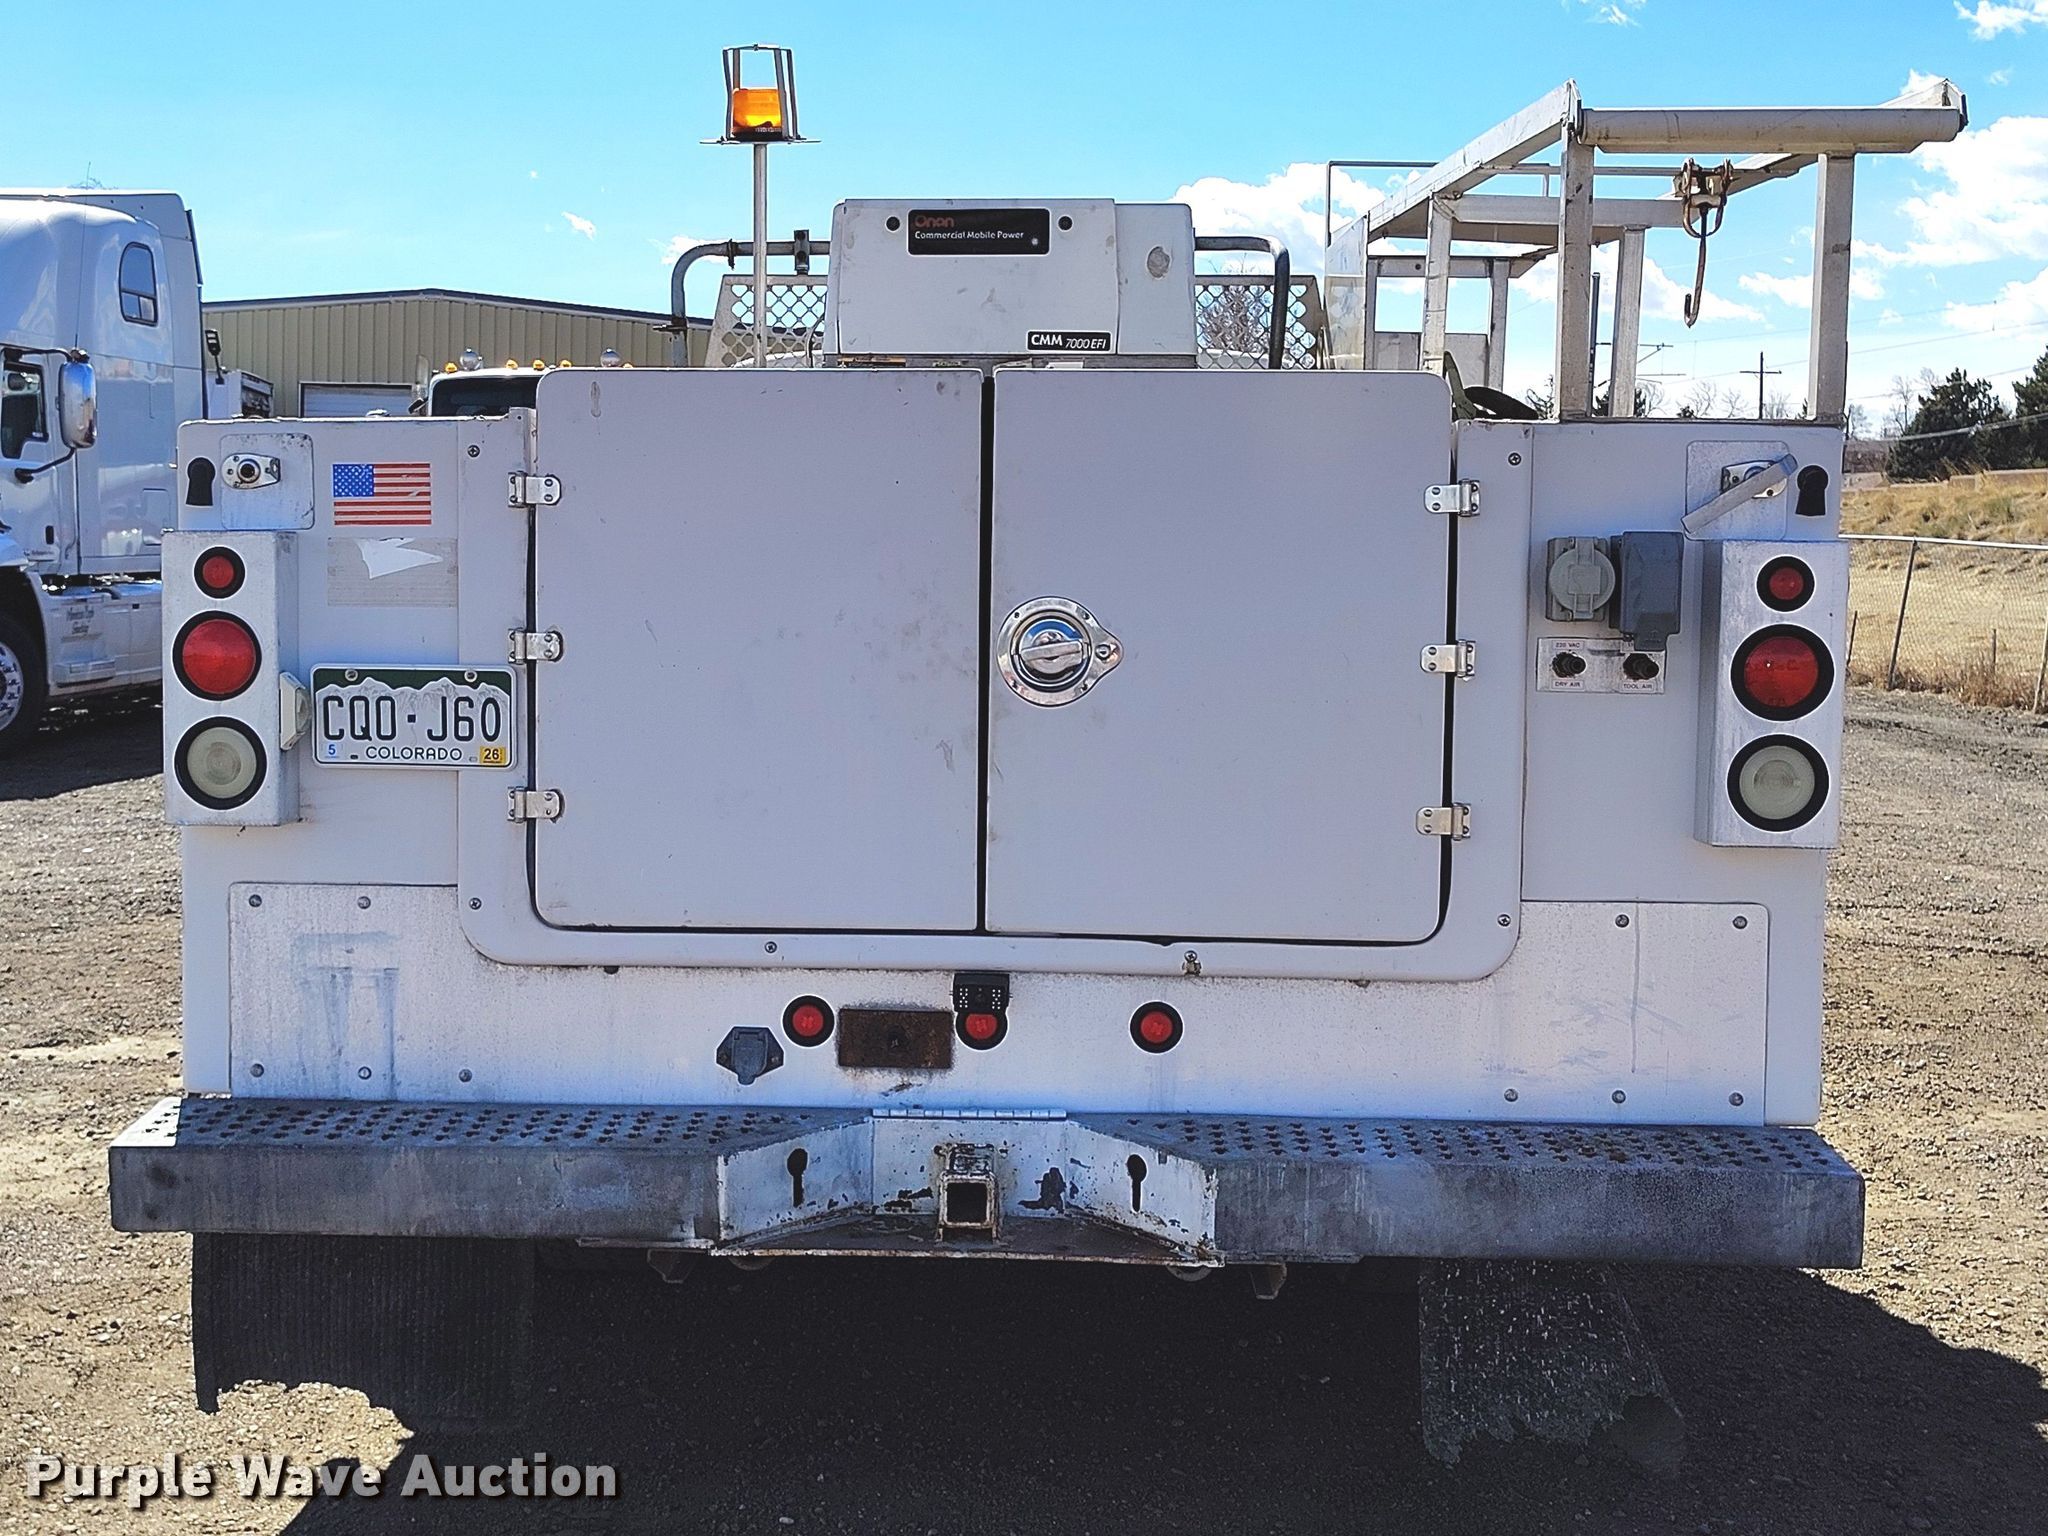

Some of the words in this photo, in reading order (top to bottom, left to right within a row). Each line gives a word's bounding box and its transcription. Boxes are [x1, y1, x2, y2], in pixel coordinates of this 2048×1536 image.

[914, 215, 955, 228] Onan
[914, 231, 966, 239] Commercial
[966, 231, 995, 239] Mobile
[997, 231, 1024, 239] Power
[1031, 334, 1063, 346] CMM
[1065, 338, 1090, 349] 7000
[1090, 338, 1107, 349] EFI
[328, 744, 336, 755] 5
[365, 746, 463, 761] COLORADO
[483, 748, 500, 760] 26
